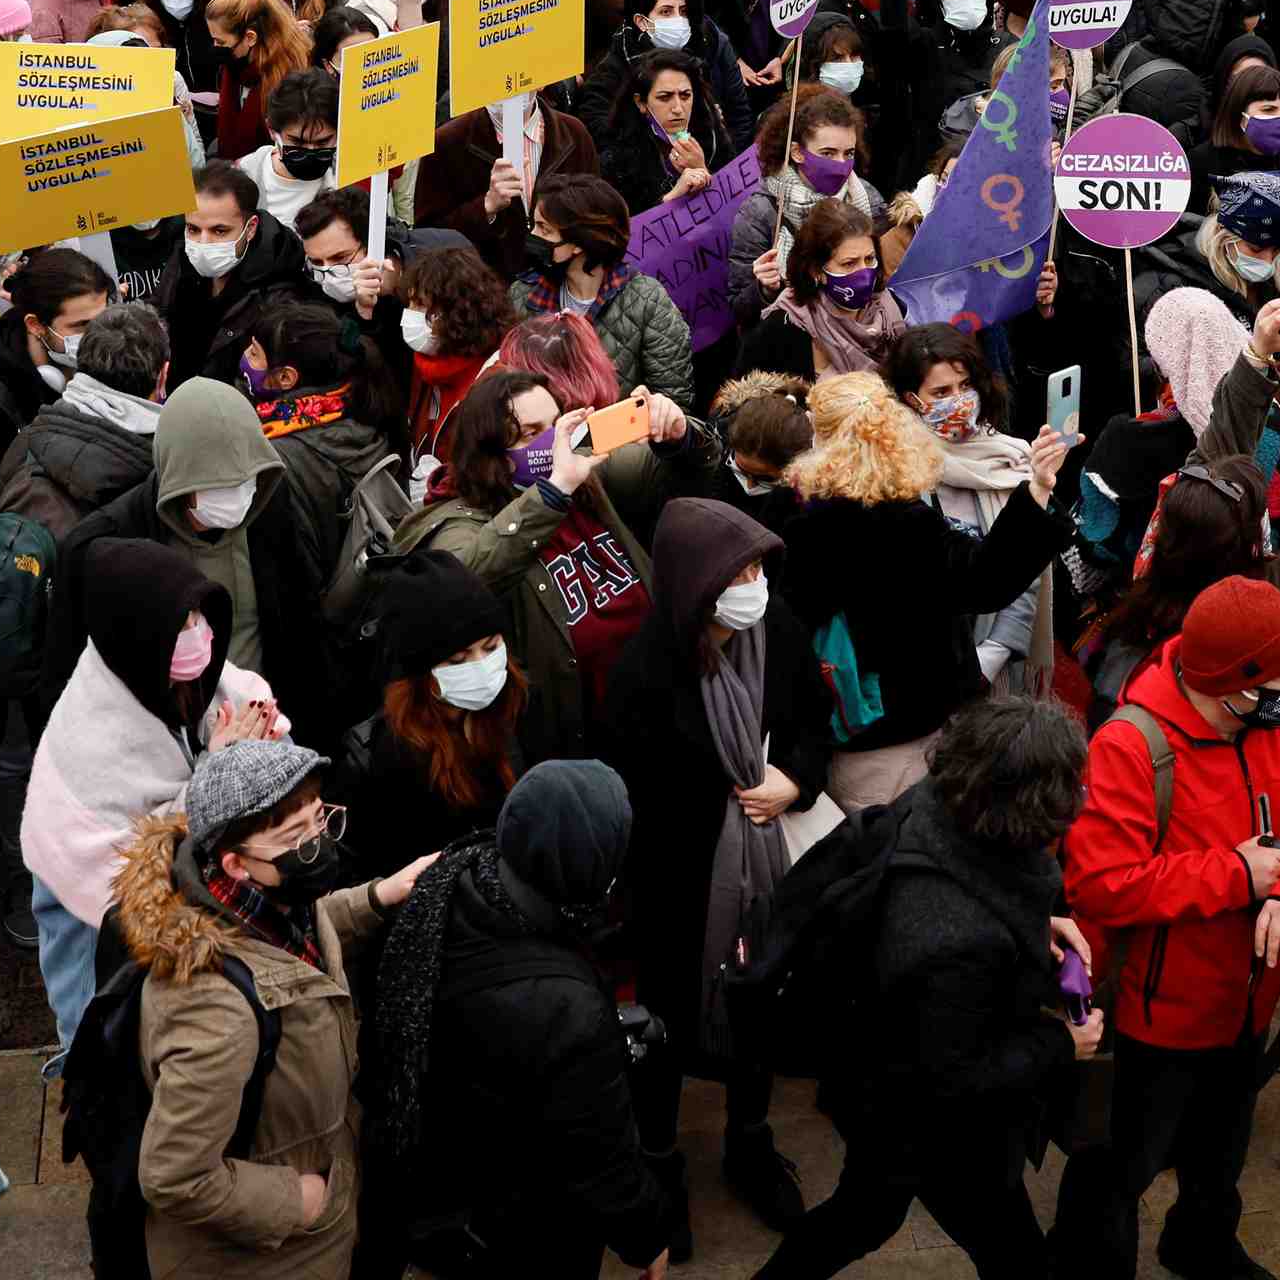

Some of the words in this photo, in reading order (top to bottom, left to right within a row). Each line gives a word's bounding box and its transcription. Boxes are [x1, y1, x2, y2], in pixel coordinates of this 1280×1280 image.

[1050, 6, 1117, 26] UYGULA!
[478, 23, 526, 48] UYGULA!
[18, 53, 97, 70] İSTANBUL
[362, 43, 402, 67] İSTANBUL
[17, 73, 134, 94] SÖZLEŞMESİNİ
[361, 56, 419, 90] SÖZLEŞMESİNİ
[16, 94, 84, 110] UYGULA!
[360, 88, 395, 112] UYGULA!
[19, 133, 103, 161] İSTANBUL
[23, 139, 144, 176] SÖZLEŞMESİNİ
[1060, 151, 1188, 173] CEZASIZLIĞA
[27, 167, 98, 193] UYGULA!
[1078, 179, 1162, 211] SON!
